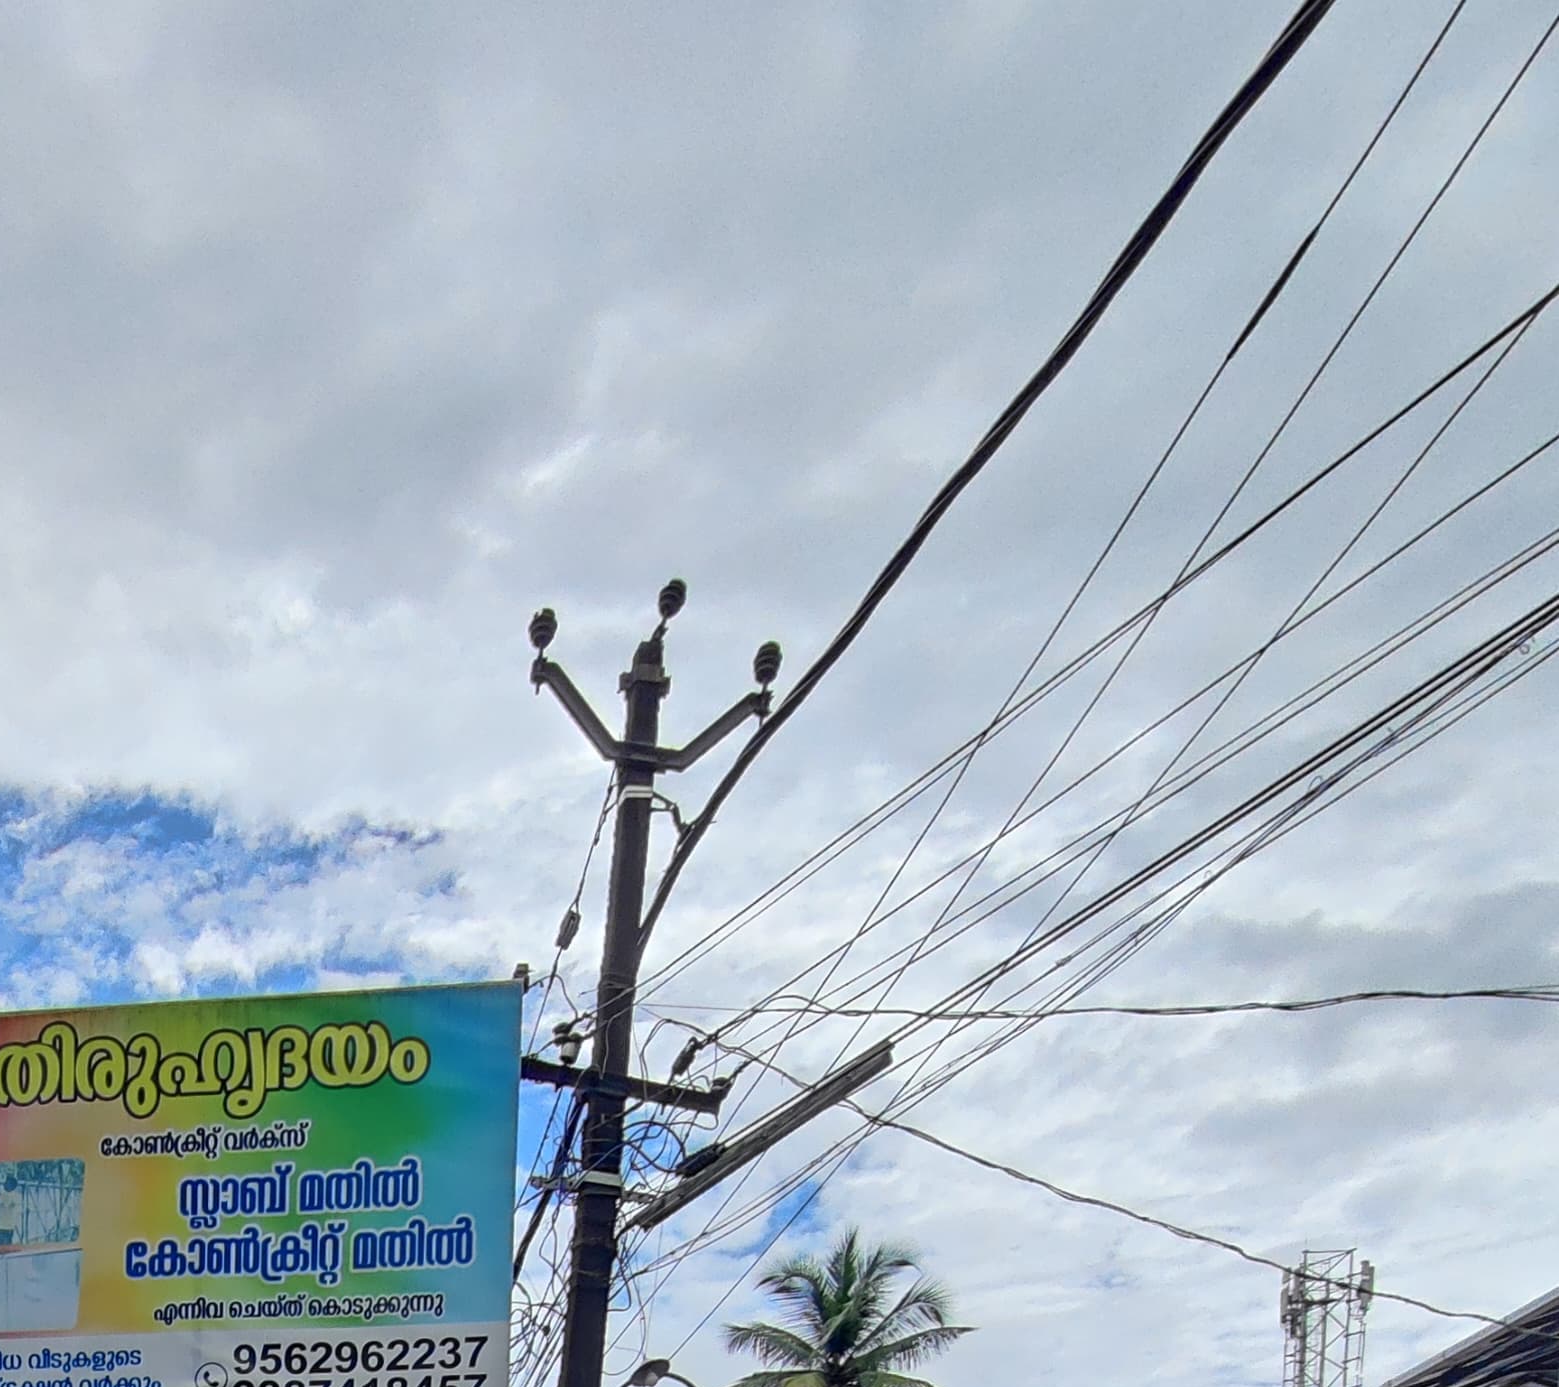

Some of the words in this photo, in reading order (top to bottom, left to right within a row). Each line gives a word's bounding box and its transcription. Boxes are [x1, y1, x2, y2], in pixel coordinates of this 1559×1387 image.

[299, 1158, 420, 1212] മതിൽ
[352, 1216, 473, 1270] മതിൽ
[153, 1297, 223, 1325] എന്നിവ
[232, 1336, 489, 1374] 9562962237
